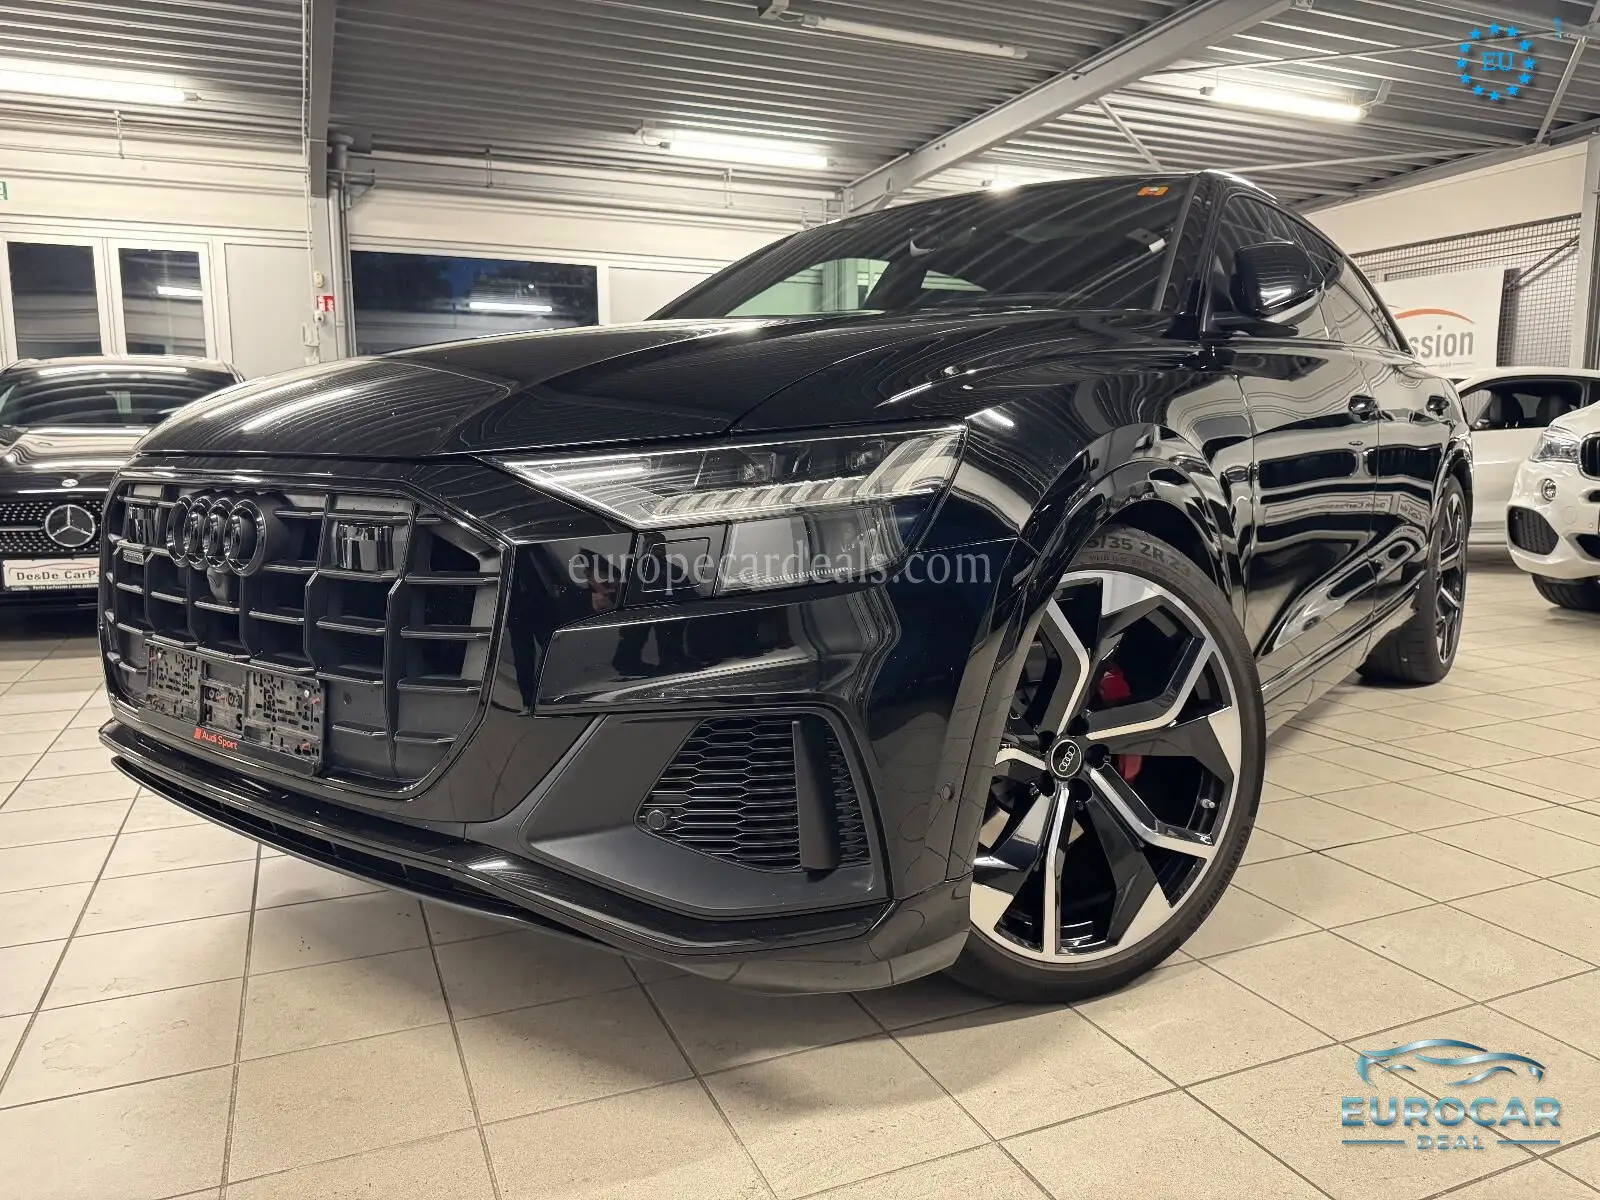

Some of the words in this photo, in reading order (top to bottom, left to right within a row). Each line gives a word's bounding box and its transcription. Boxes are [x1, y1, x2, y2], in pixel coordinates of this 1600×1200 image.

[1139, 542, 1165, 563] ZR
[202, 730, 217, 743] Audi
[218, 736, 238, 750] Sport
